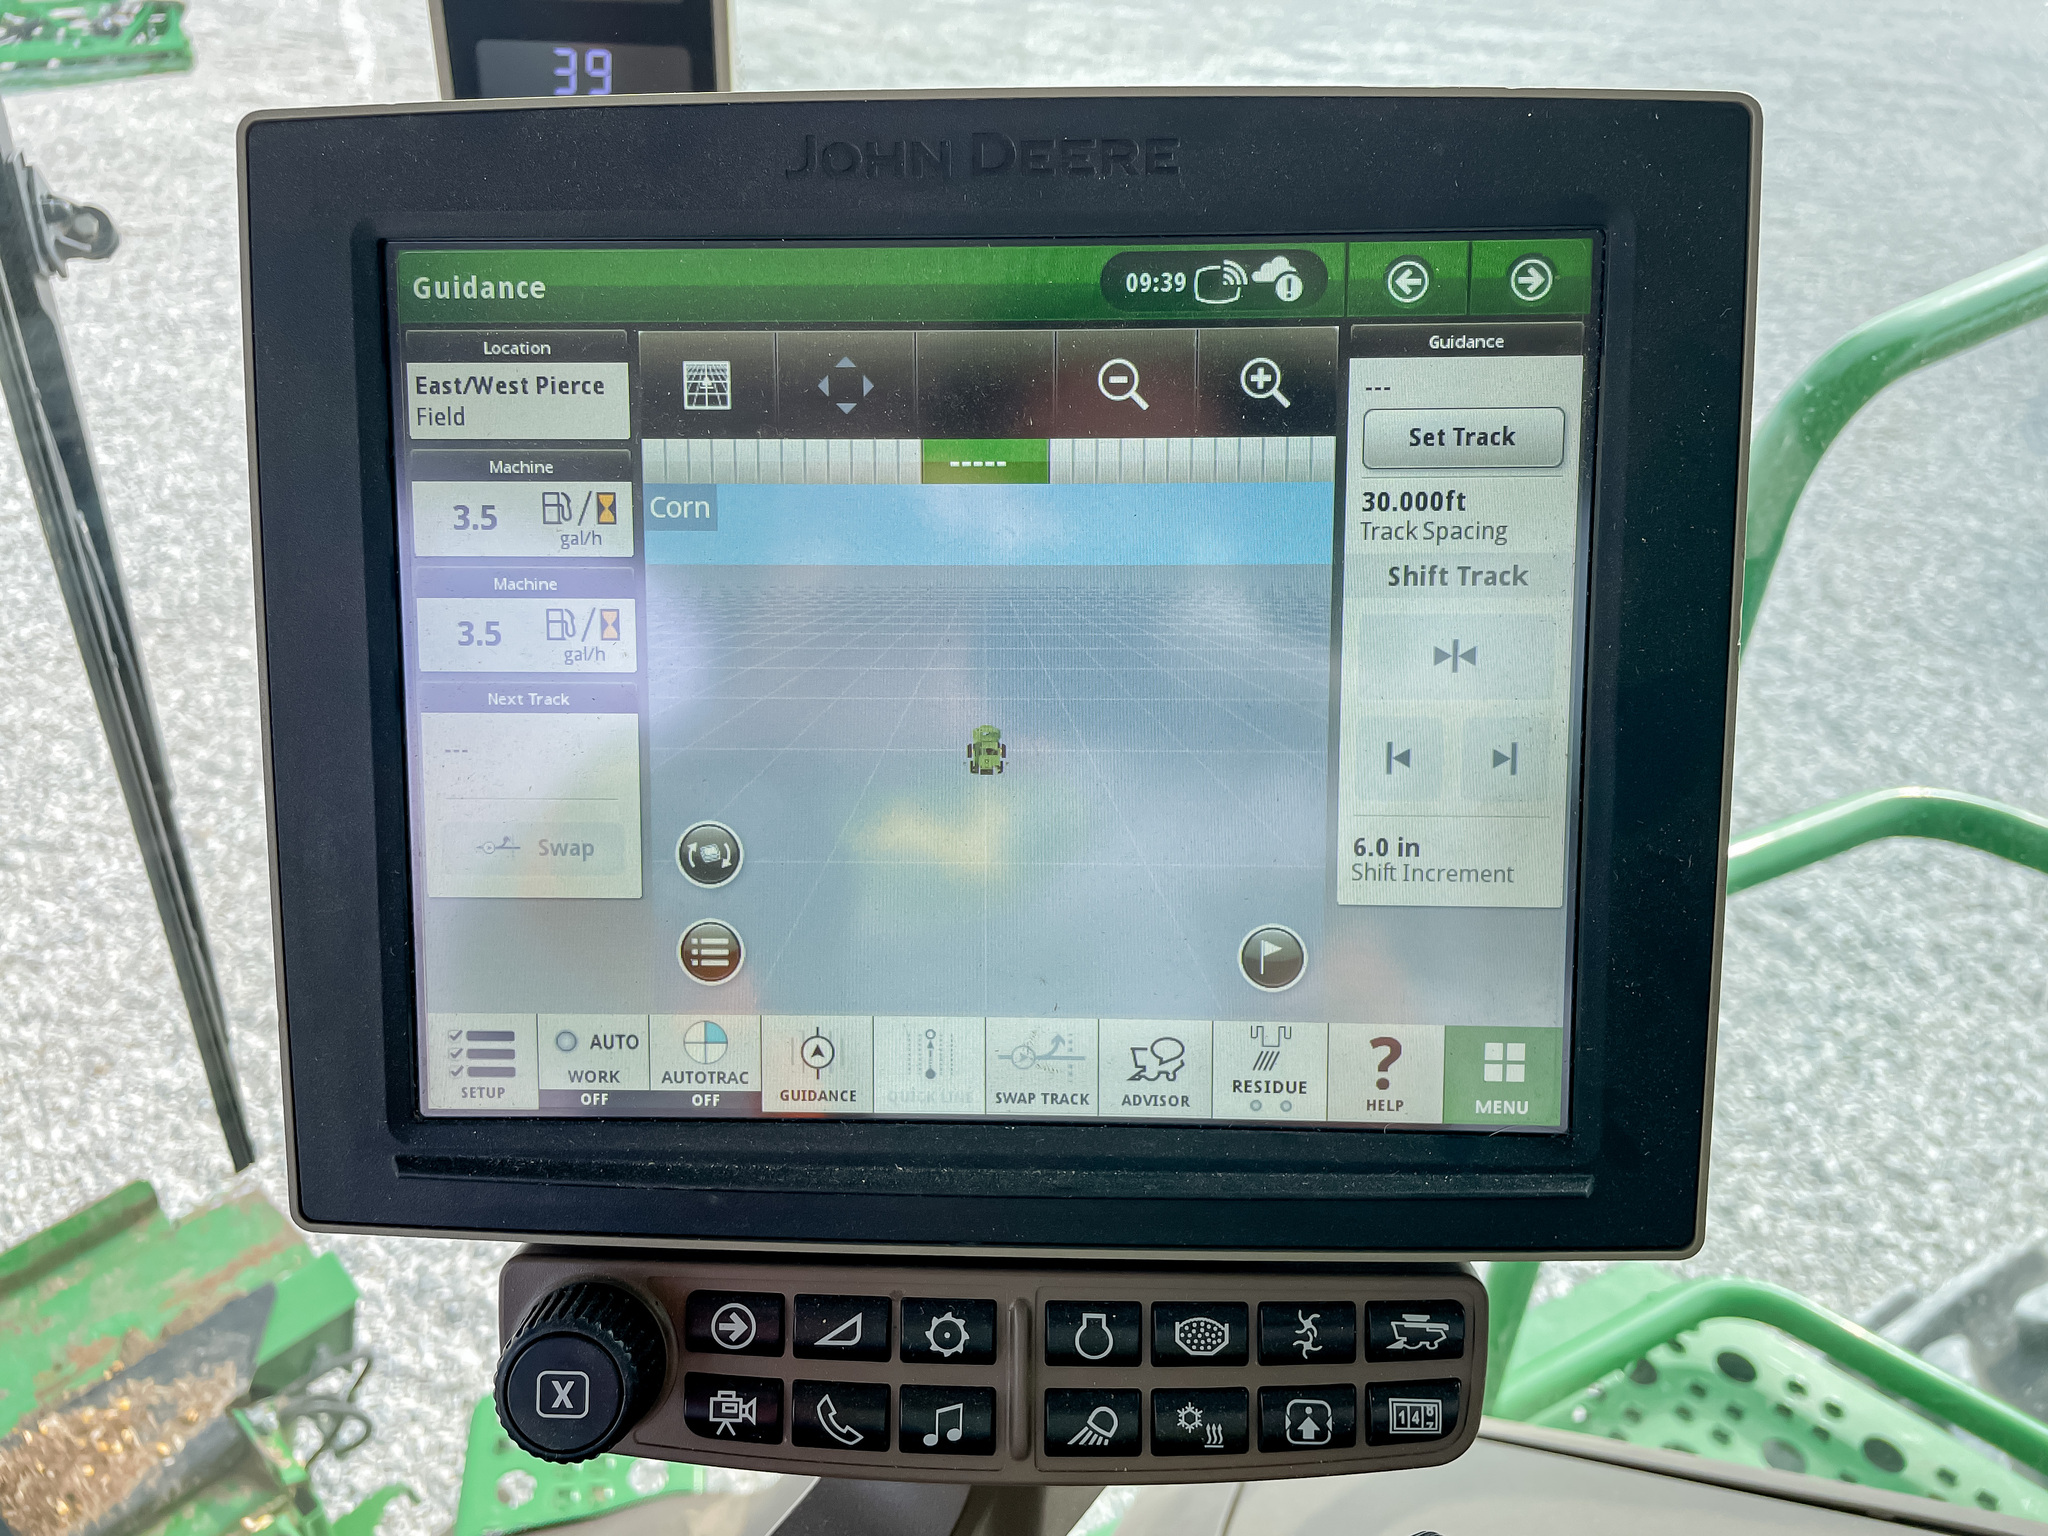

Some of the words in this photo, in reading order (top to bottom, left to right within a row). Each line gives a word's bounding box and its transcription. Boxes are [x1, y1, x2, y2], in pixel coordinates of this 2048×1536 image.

[553, 47, 613, 96] 39
[785, 133, 953, 180] JOHN
[971, 131, 1182, 176] DEERE
[412, 275, 547, 301] Guidance
[1125, 271, 1188, 294] 09:39
[483, 341, 552, 356] Location
[1429, 334, 1505, 351] Guidance
[415, 374, 530, 396] East/West
[536, 376, 605, 396] Pierce
[416, 406, 466, 427] Field
[1408, 426, 1446, 447] Set
[1453, 424, 1517, 447] Track
[489, 460, 554, 475] Machine
[649, 496, 711, 519] Corn
[1361, 490, 1467, 513] 30.000ft
[452, 504, 499, 532] 3.5
[560, 530, 604, 550] gal/h
[1360, 521, 1418, 542] Track
[1422, 521, 1509, 546] Spacing
[493, 577, 558, 592] Machine
[1388, 564, 1450, 587] Shift
[1457, 564, 1530, 587] Track
[456, 620, 503, 648] 3.5
[563, 646, 607, 666] gal/h
[487, 692, 525, 707] Next
[528, 691, 571, 707] Track
[538, 838, 596, 862] Swap
[1353, 837, 1389, 857] 6.0
[1397, 836, 1421, 858] in
[1351, 861, 1397, 882] Shift
[1402, 863, 1516, 883] Increment
[590, 1033, 640, 1051] AUTO
[568, 1069, 621, 1085] WORK
[661, 1070, 750, 1086] AUTOTRAC
[461, 1086, 506, 1100] SETUP
[780, 1089, 857, 1103] GUIDANCE
[1232, 1079, 1308, 1096] RESIDUE
[580, 1092, 610, 1107] OFF
[691, 1093, 721, 1108] OFF
[995, 1091, 1036, 1106] SWAP
[1041, 1092, 1091, 1107] TRACK
[1121, 1094, 1191, 1109] ADVISOR
[1366, 1099, 1405, 1113] HELP
[1475, 1100, 1530, 1116] MENU
